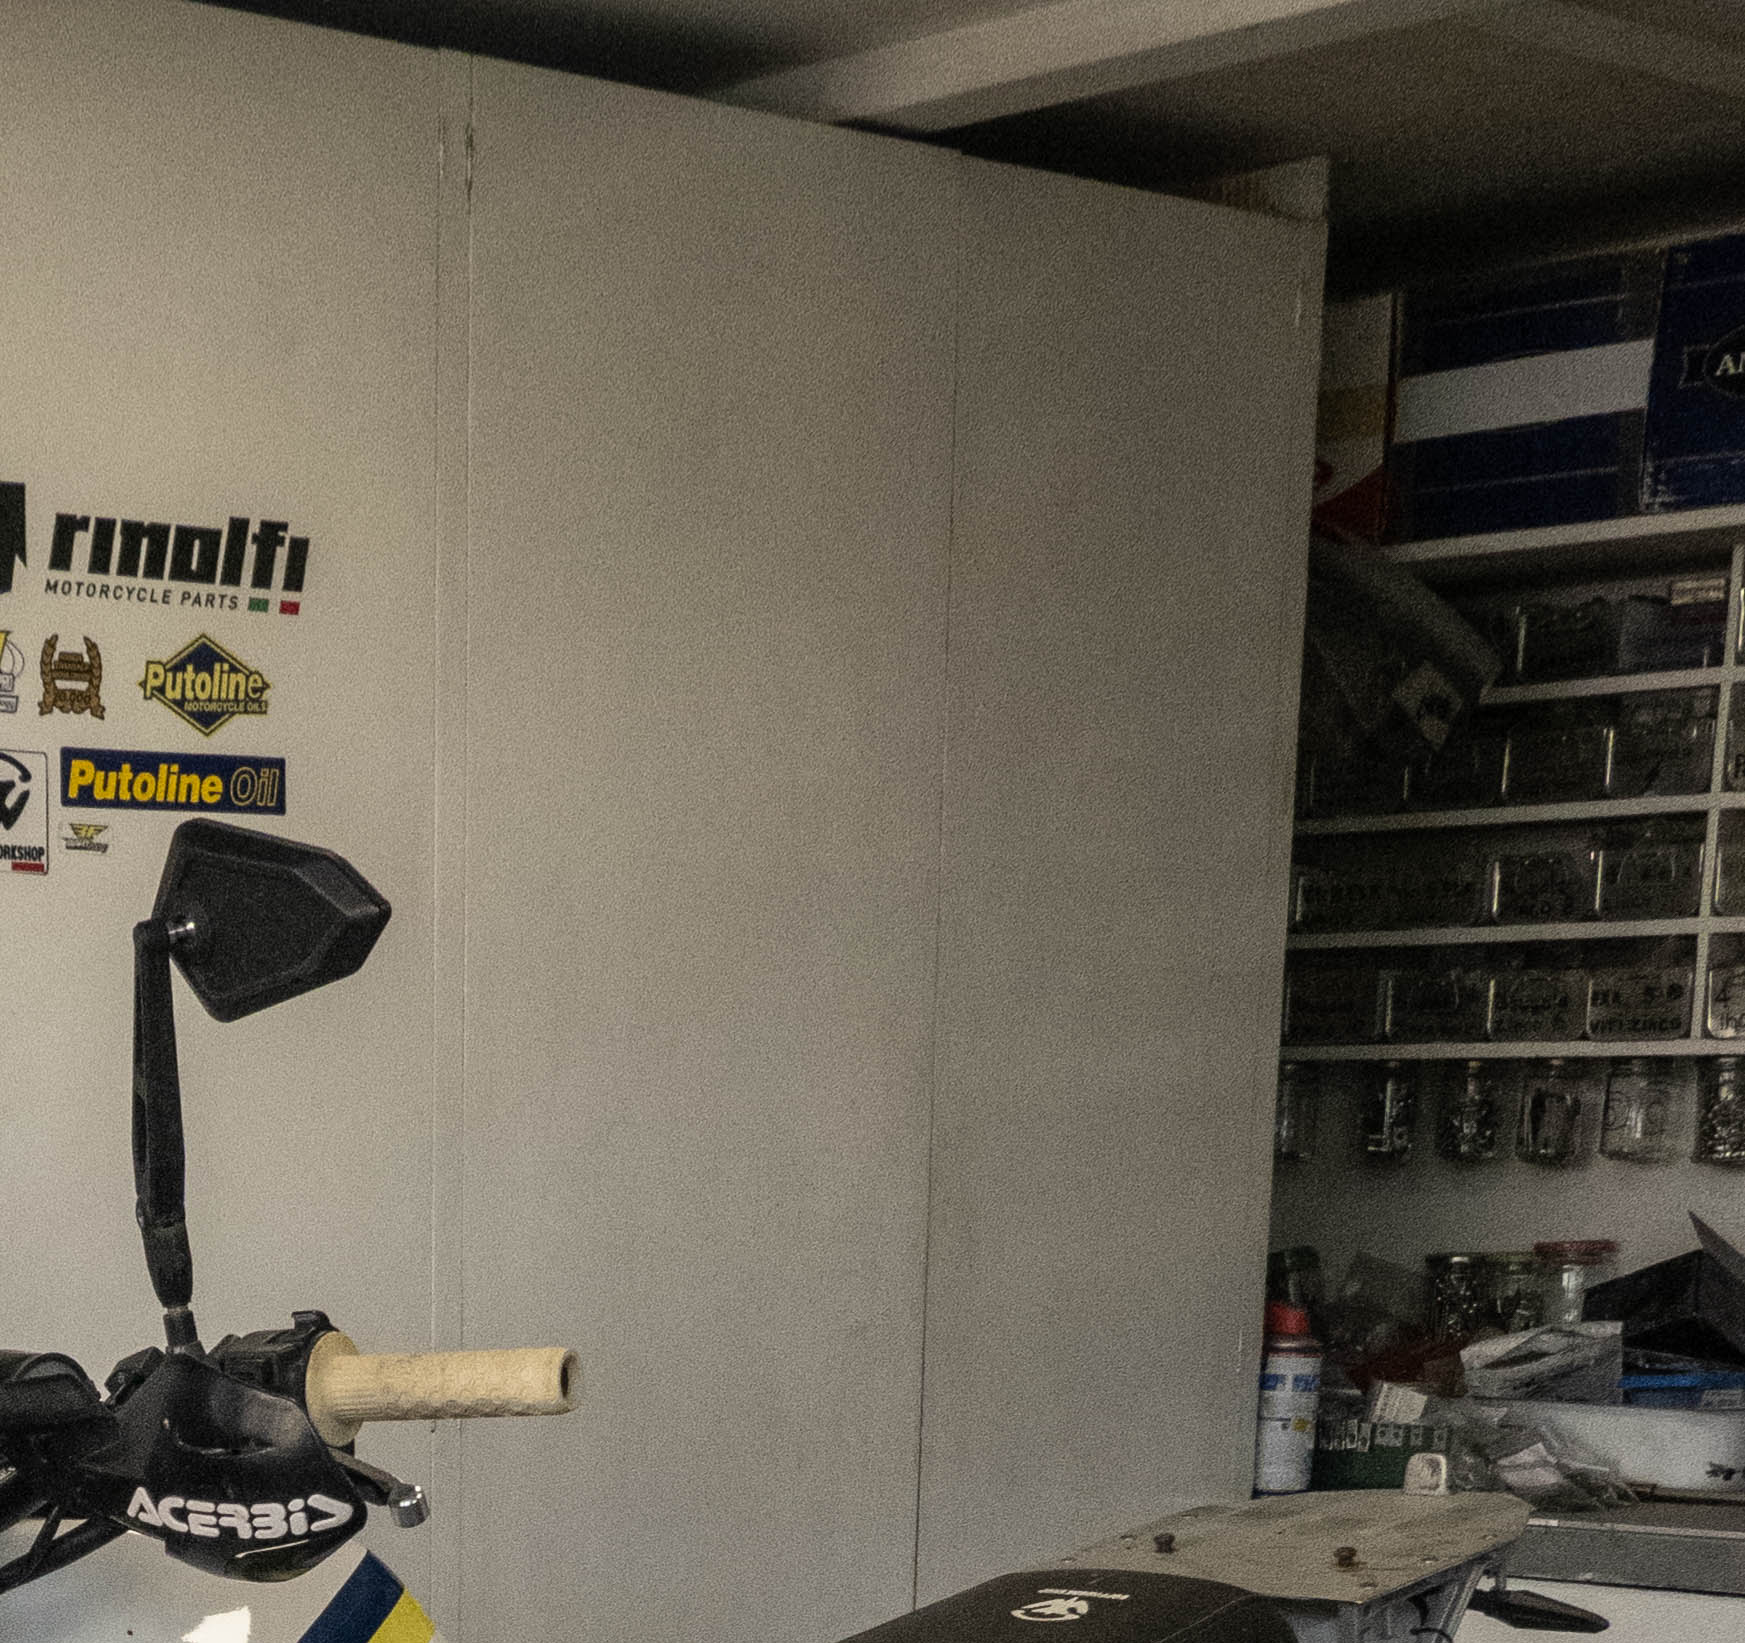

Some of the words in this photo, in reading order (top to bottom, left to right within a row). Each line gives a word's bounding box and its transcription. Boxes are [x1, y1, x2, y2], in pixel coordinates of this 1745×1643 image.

[44, 578, 171, 605] MOTORCYCLE
[180, 592, 239, 612] PARTS
[145, 660, 265, 700] Putoline
[184, 700, 245, 712] MOTORCYCLE
[67, 759, 224, 804] Putoline
[229, 766, 280, 807] Oil
